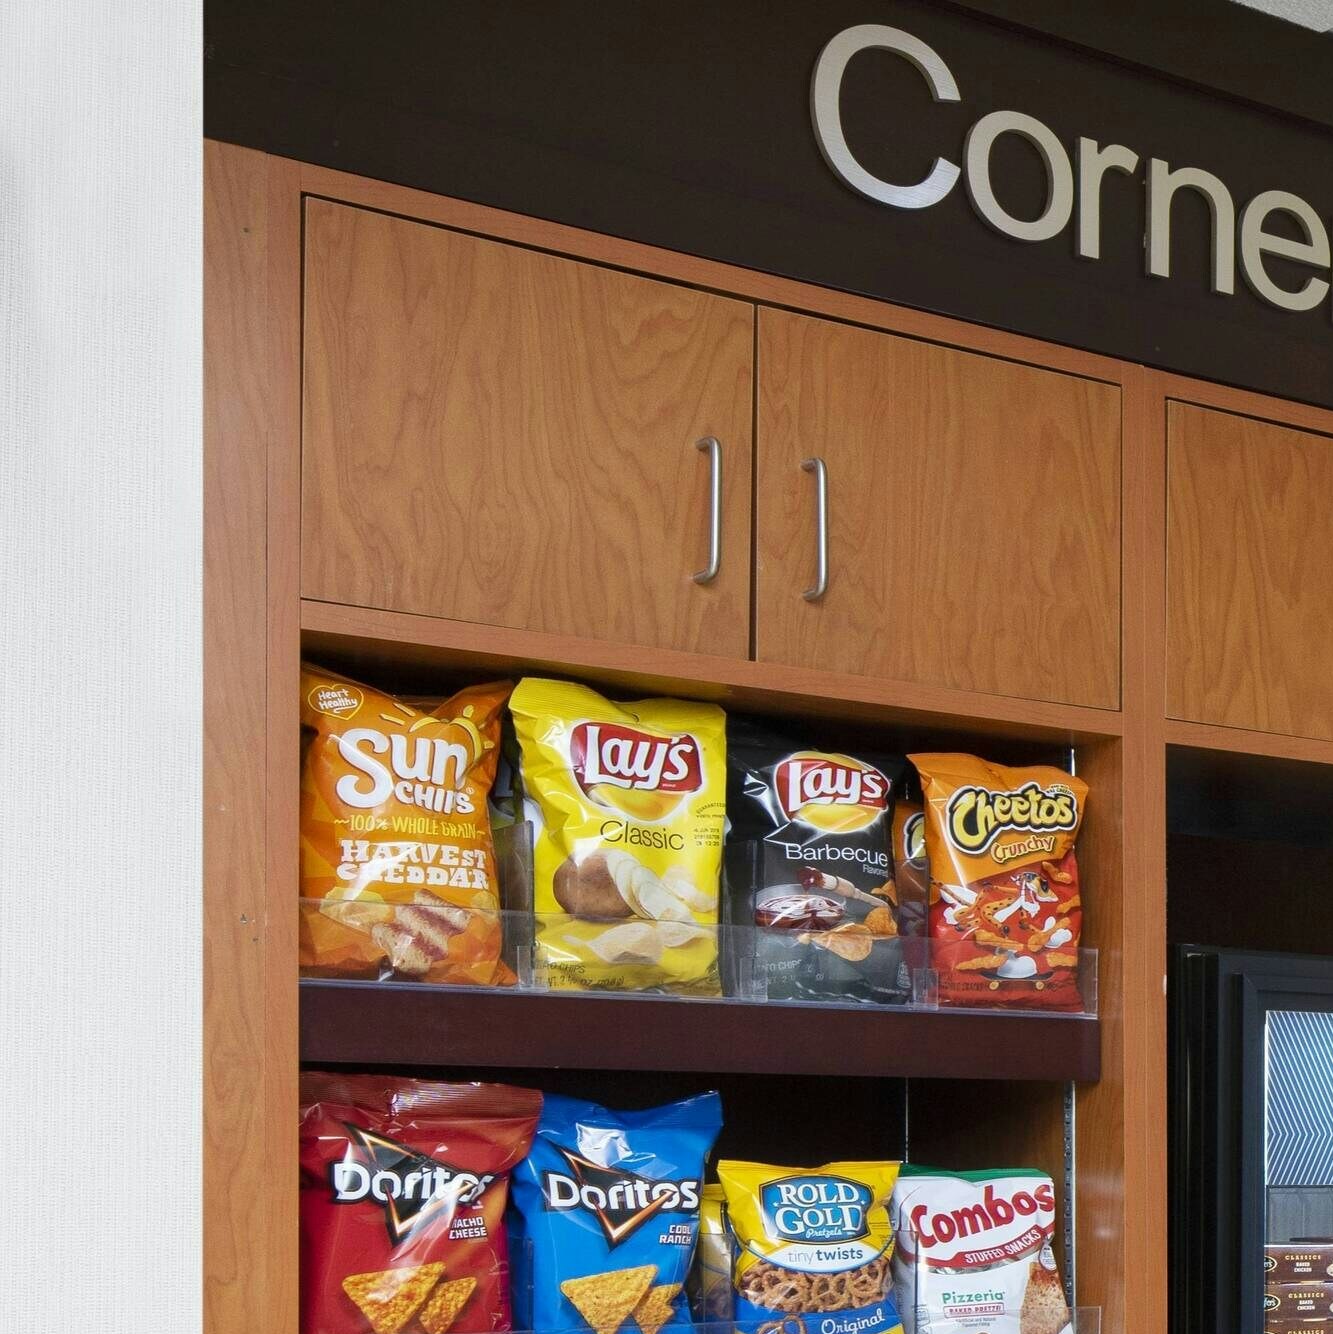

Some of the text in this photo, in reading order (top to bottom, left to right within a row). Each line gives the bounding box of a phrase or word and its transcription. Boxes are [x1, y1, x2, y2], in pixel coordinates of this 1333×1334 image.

[317, 688, 350, 702] Heart
[318, 697, 358, 713] Healthy
[336, 727, 468, 809] Sun
[584, 725, 694, 790] Lay's
[788, 762, 883, 812] Lay's
[350, 814, 477, 840] 100% WHOLE GRAIN
[951, 784, 1075, 848] Cheetos
[599, 820, 685, 851] Classic
[990, 834, 1057, 864] Crunchy
[340, 839, 487, 869] HARVEST
[785, 842, 889, 867] Barbecue
[333, 1162, 495, 1202] Doritos
[549, 1172, 699, 1211] Doritos
[781, 1183, 860, 1207] ROLD
[669, 1224, 691, 1235] COOL
[775, 1199, 865, 1231] GOLD
[910, 1184, 1056, 1249] Combos
[448, 1225, 487, 1239] CHEESE
[659, 1233, 692, 1245] RANCH
[805, 1226, 843, 1239] Pretzels
[965, 1228, 1043, 1265] STUFFED SNACKS
[787, 1247, 864, 1265] tiny twists
[941, 1289, 1004, 1305] Pizzeria
